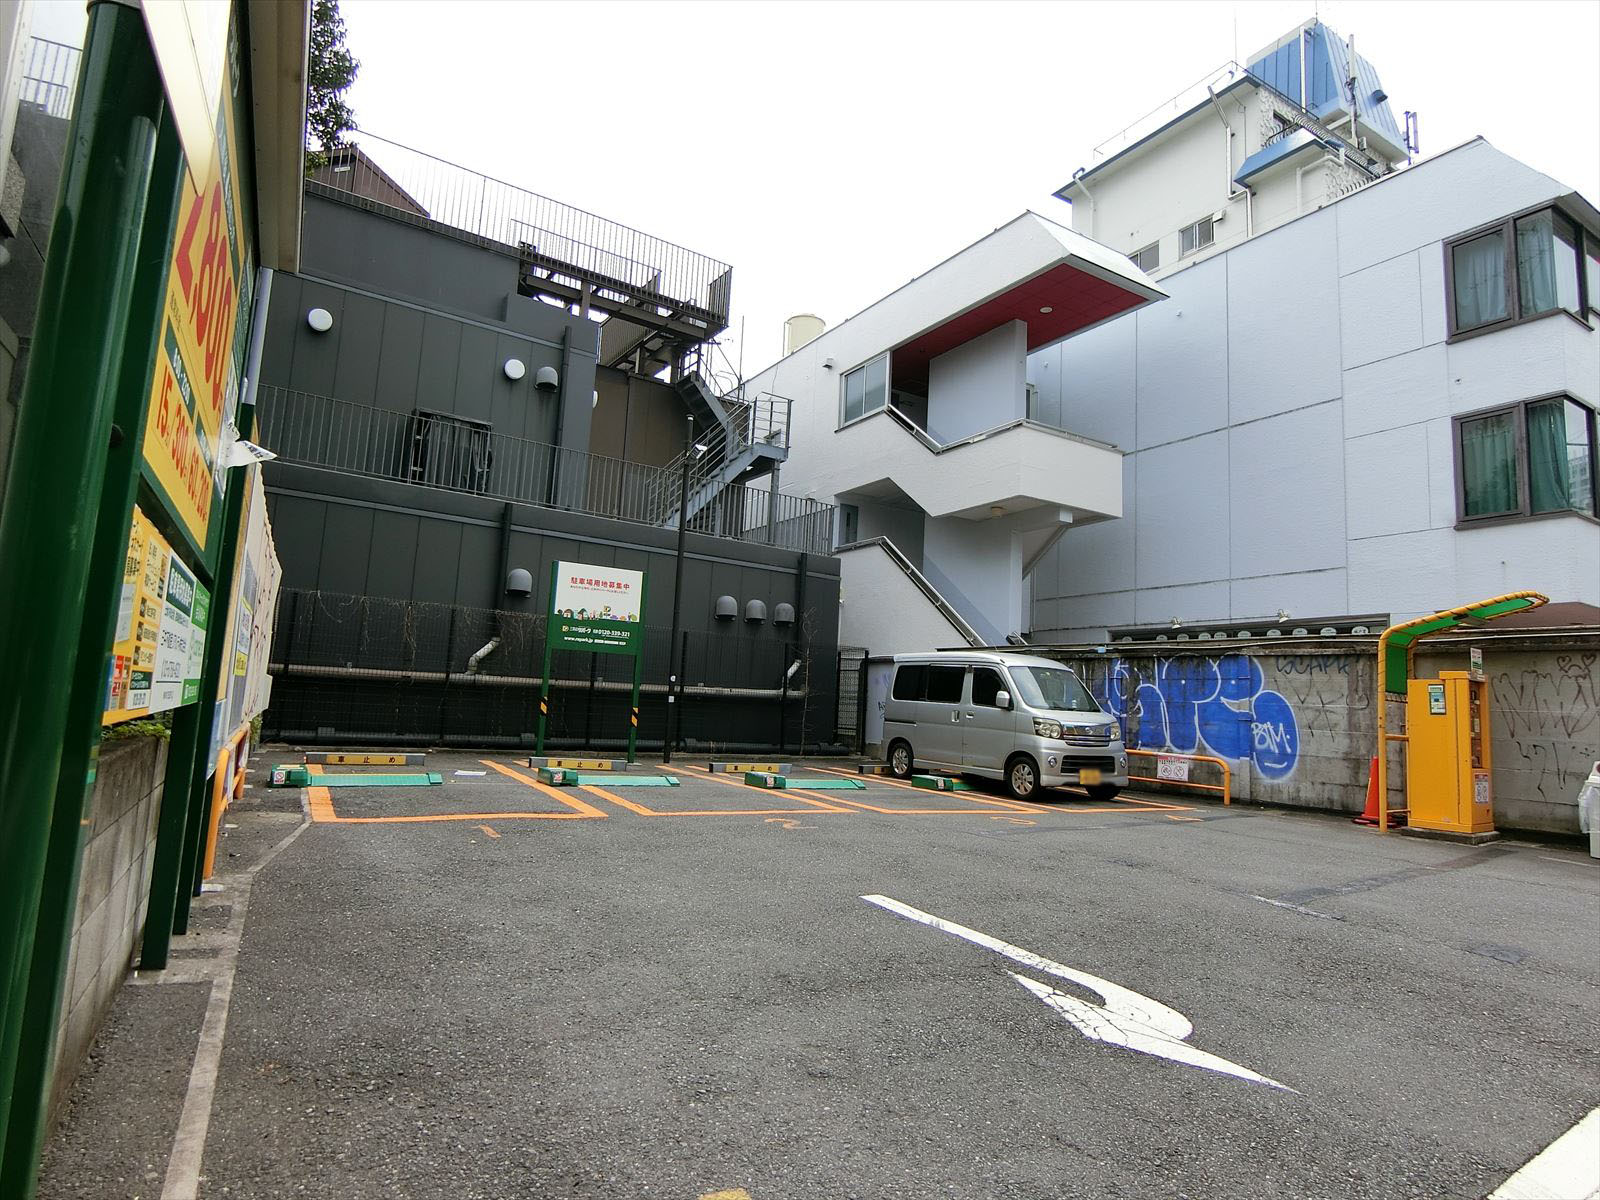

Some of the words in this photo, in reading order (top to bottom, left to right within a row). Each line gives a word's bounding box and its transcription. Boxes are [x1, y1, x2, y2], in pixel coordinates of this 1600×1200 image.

[570, 576, 630, 590] 駐車場用地募集中
